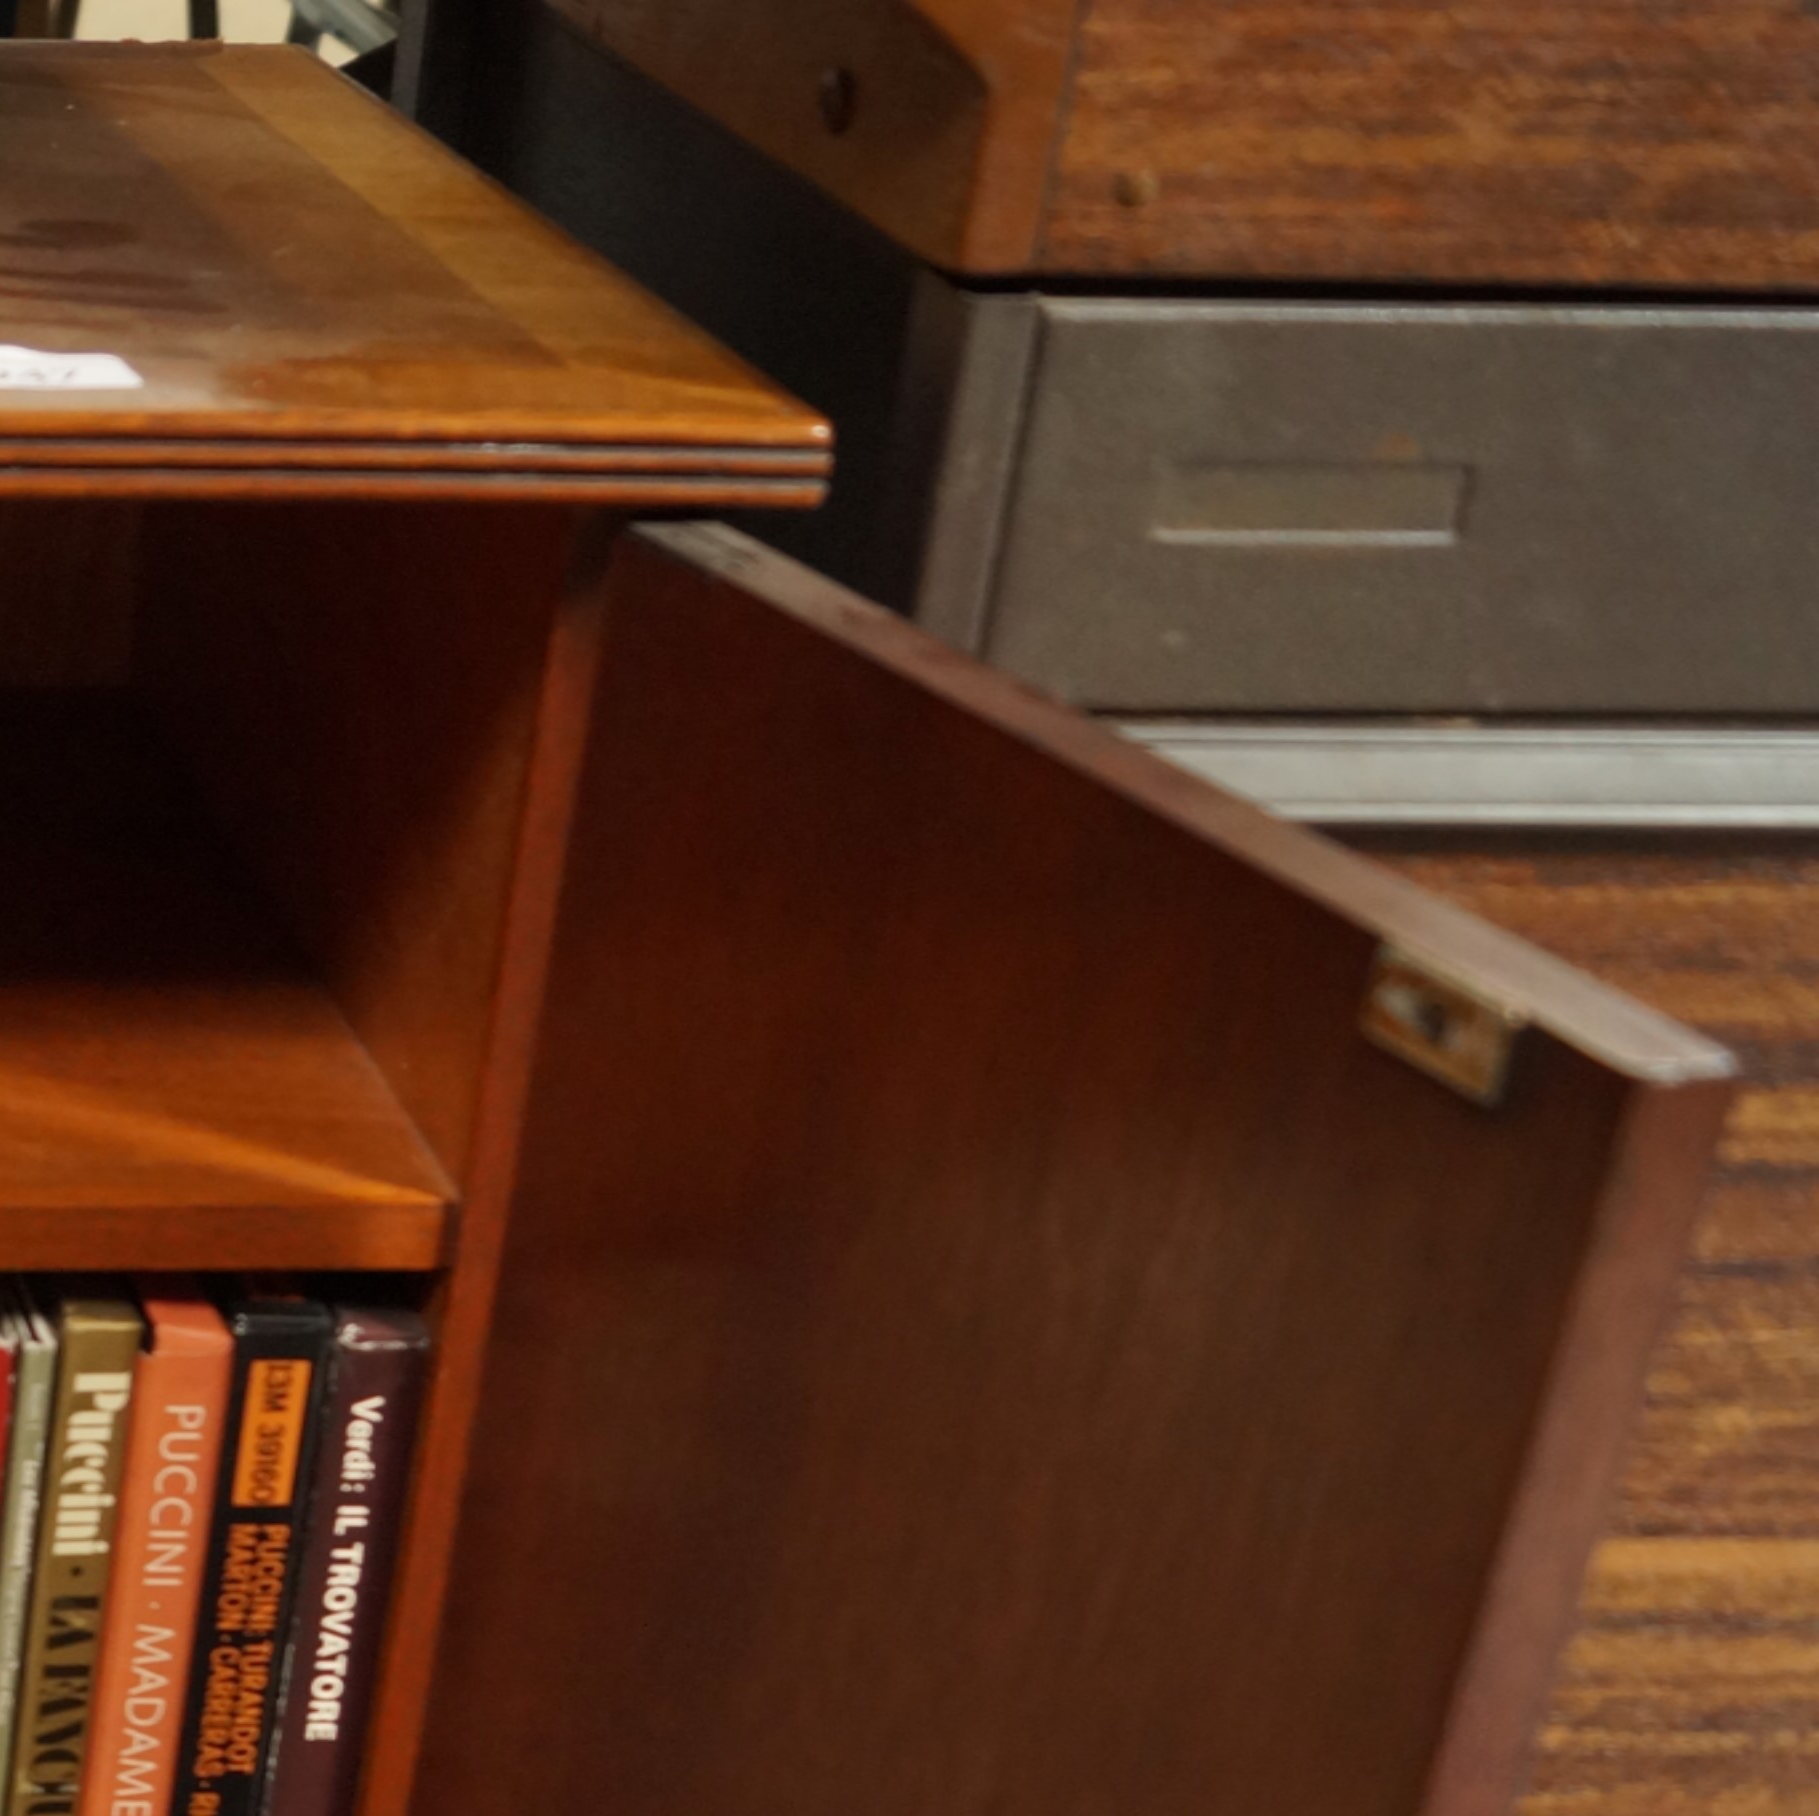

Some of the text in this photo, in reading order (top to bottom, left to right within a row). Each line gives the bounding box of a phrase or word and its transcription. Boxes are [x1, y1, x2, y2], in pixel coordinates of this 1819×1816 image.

[53, 1370, 132, 1556] Puccini
[143, 1403, 206, 1587] PUCCINI
[248, 1425, 284, 1504] 39160
[215, 1524, 258, 1630] MARTON
[304, 1396, 385, 1741] Verdi: IL TROVATORE
[193, 1647, 240, 1777] CARRERAS
[227, 1641, 273, 1774] TURANDOT
